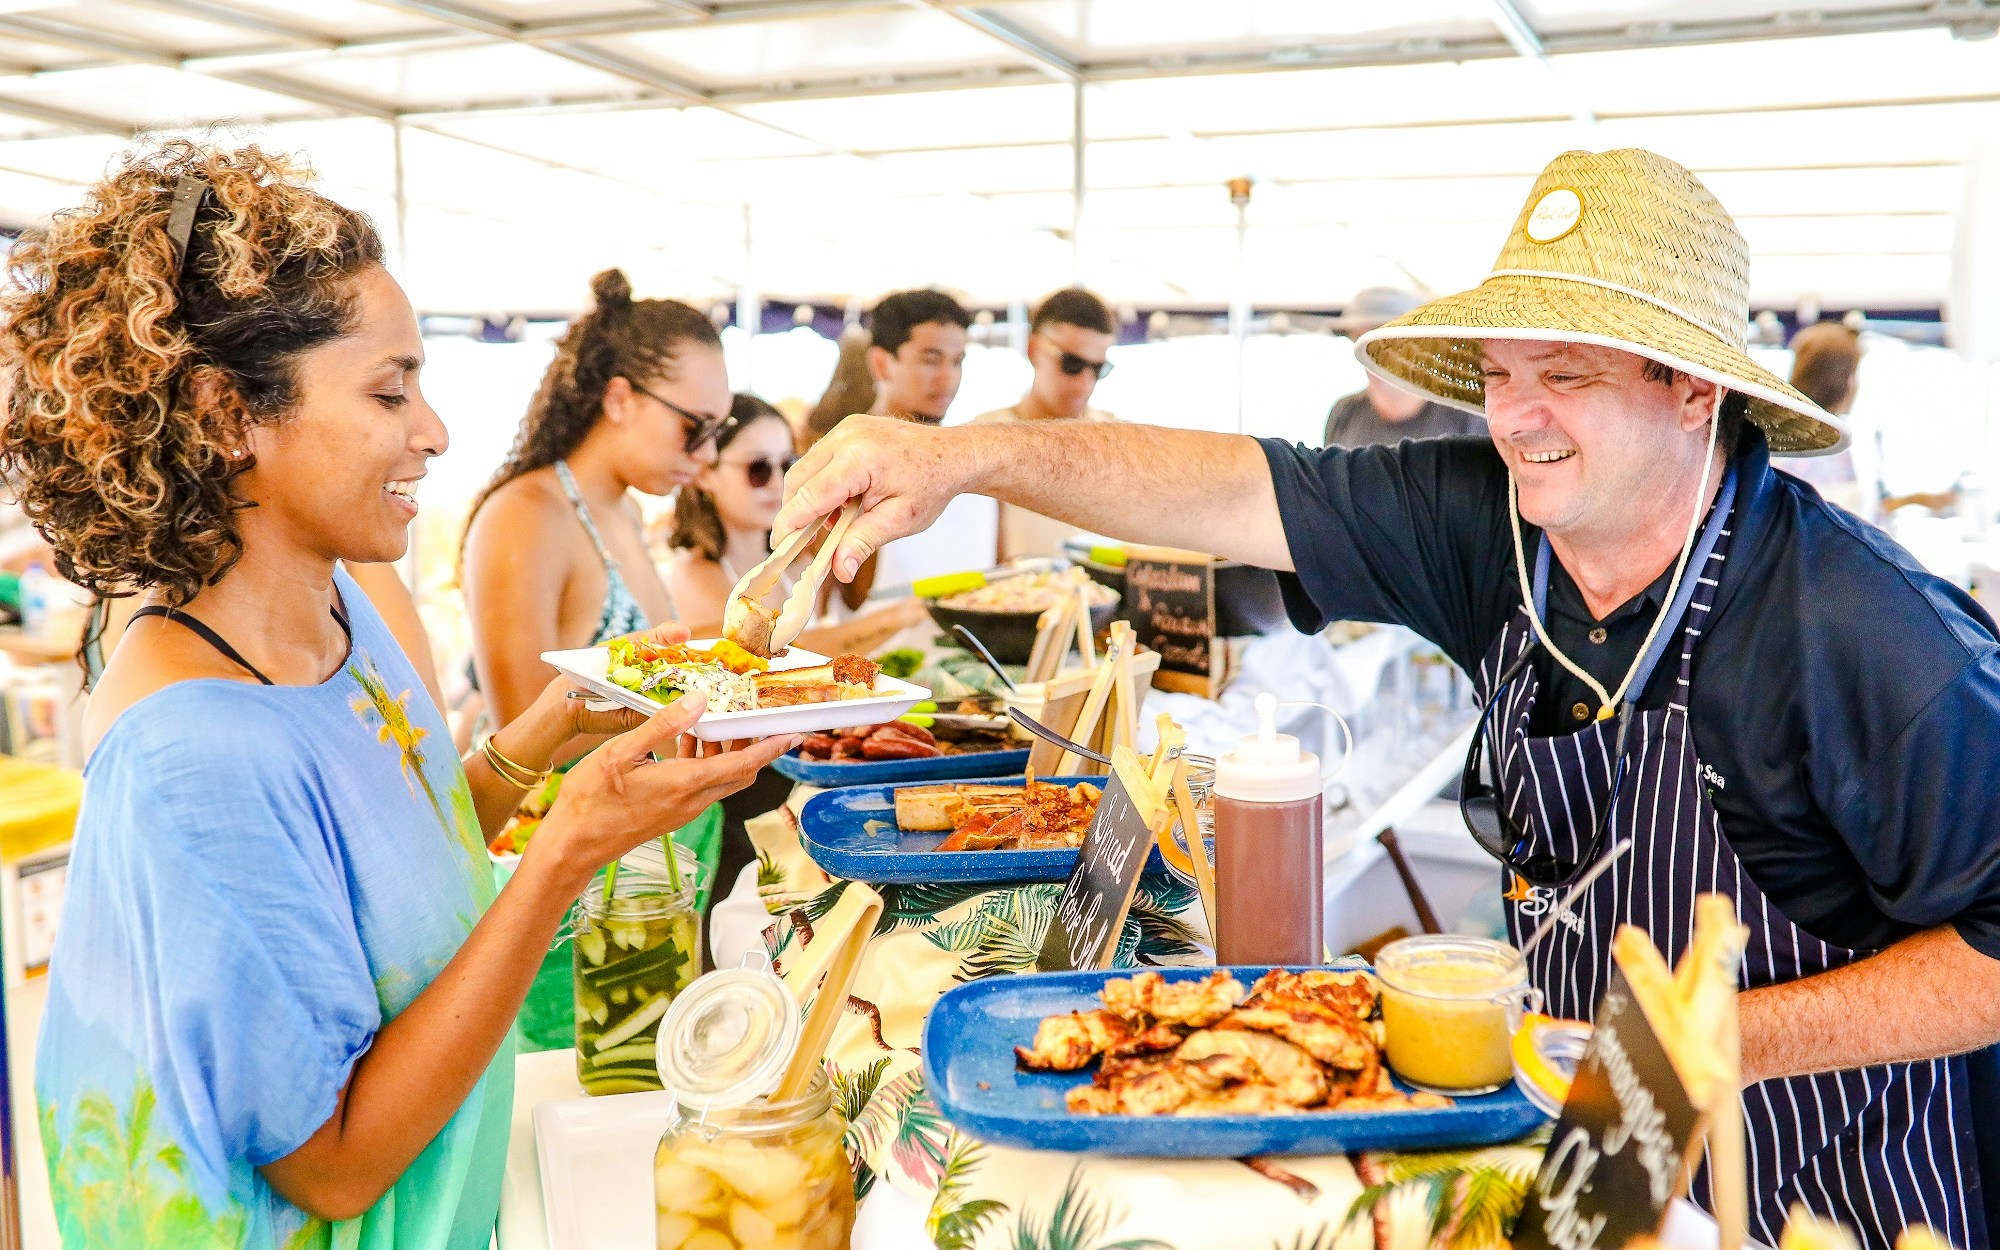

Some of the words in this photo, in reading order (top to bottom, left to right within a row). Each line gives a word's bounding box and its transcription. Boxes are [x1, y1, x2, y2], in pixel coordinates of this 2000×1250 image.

[1703, 764, 1725, 789] Sea
[1089, 793, 1136, 885] Spiced
[1057, 862, 1089, 950] Pork
[1070, 891, 1109, 971] Bell
